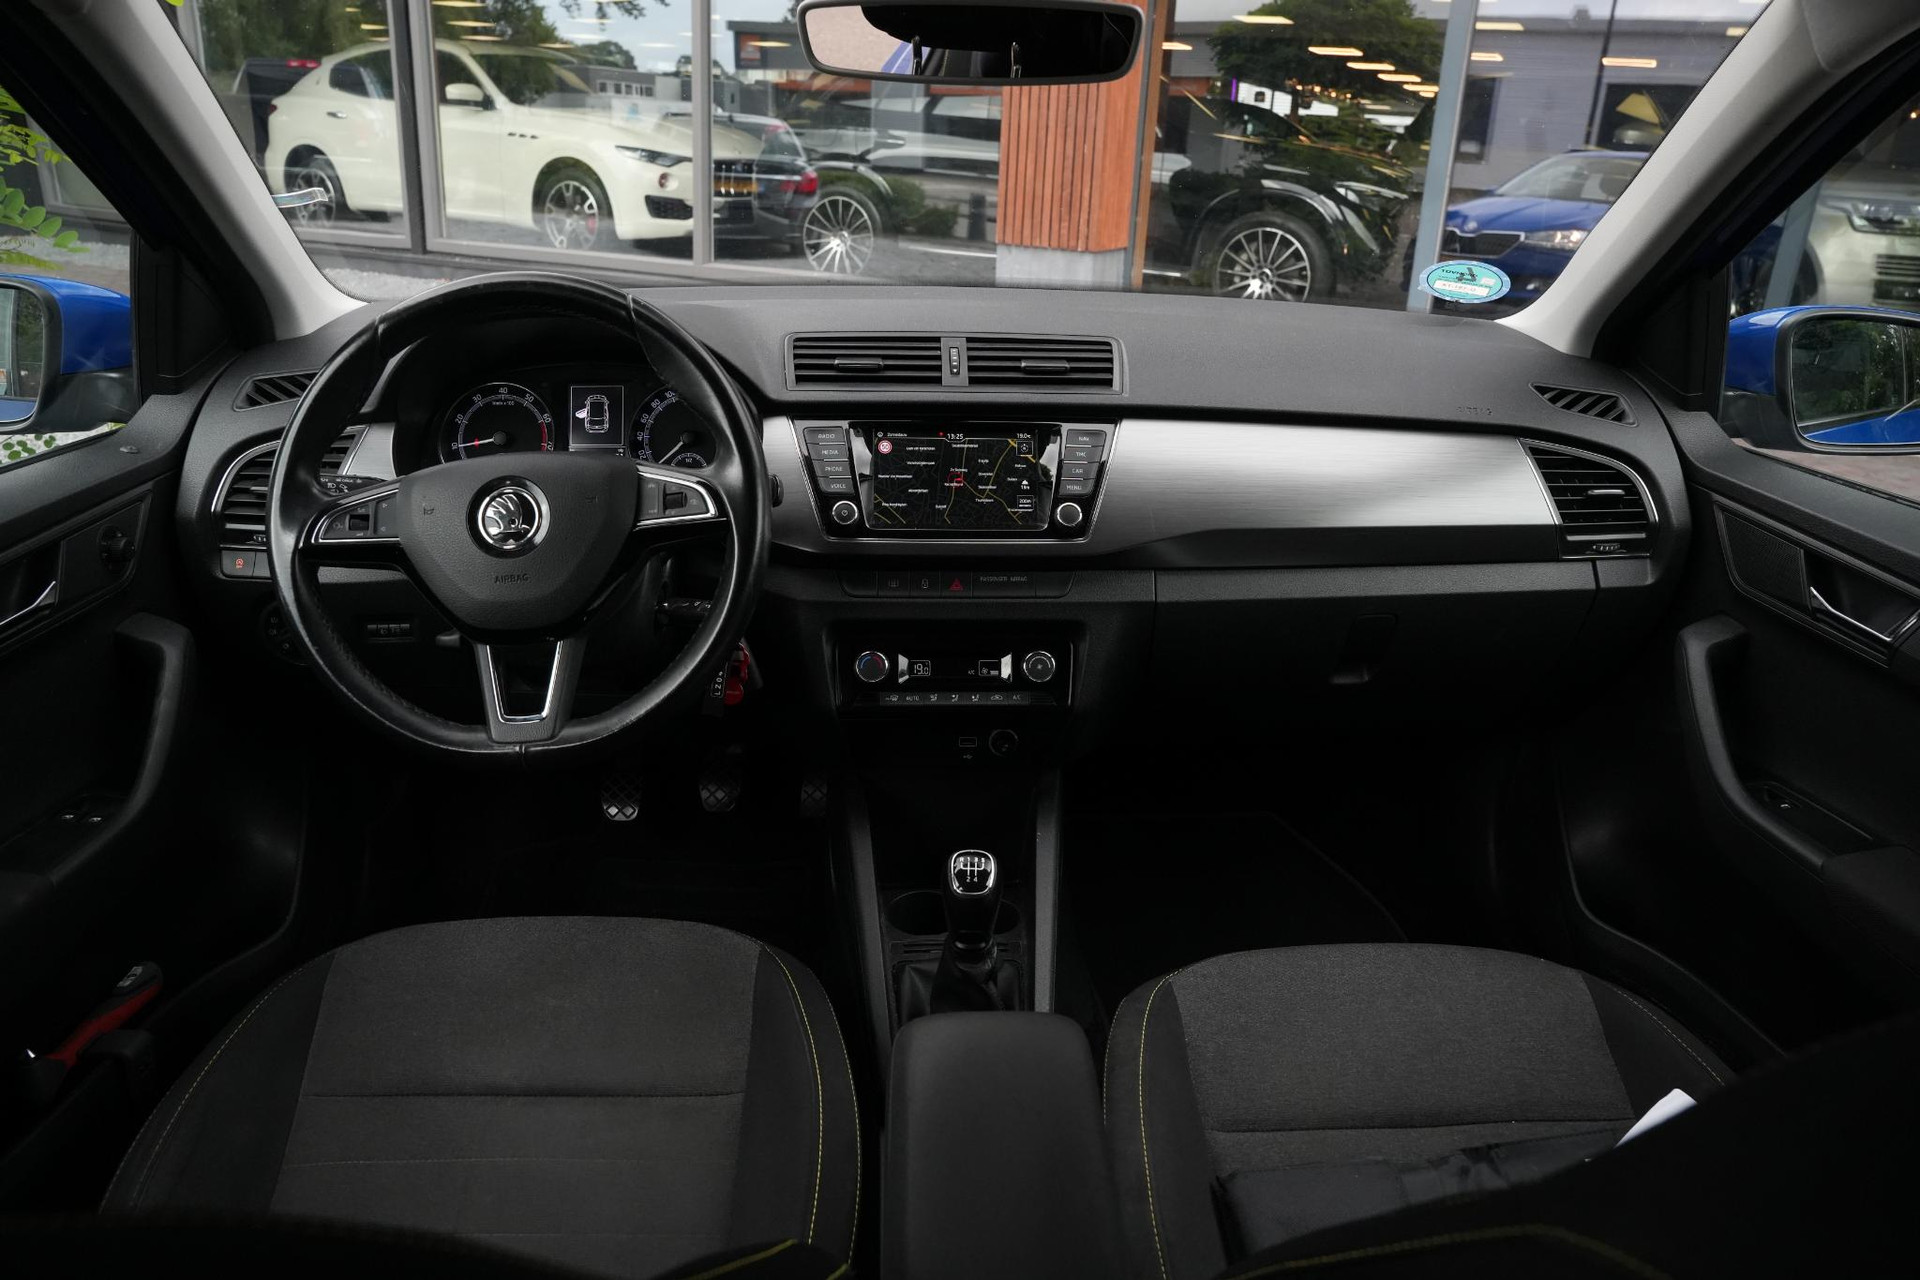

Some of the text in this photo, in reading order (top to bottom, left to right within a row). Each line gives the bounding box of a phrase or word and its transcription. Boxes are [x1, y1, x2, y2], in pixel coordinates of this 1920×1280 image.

[472, 394, 482, 403] 30
[525, 393, 534, 402] 50
[455, 413, 464, 424] 20
[636, 431, 644, 441] 40
[494, 573, 530, 584] AIRBAG
